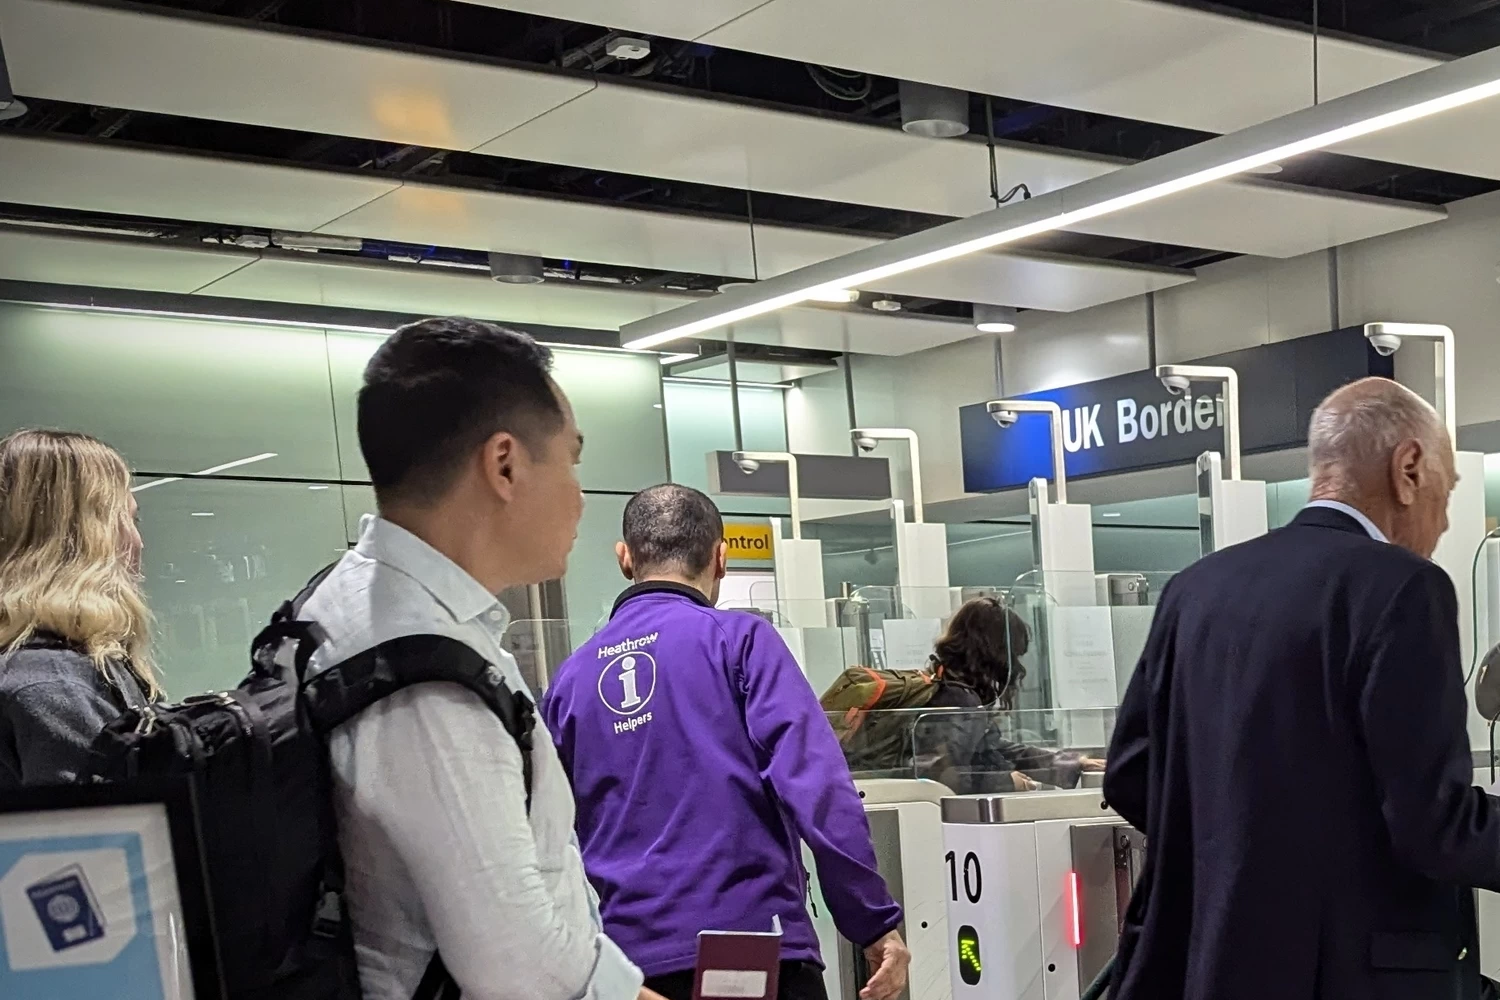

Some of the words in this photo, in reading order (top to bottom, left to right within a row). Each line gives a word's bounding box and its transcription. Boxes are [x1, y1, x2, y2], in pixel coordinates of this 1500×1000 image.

[1062, 404, 1105, 453] UK
[597, 632, 659, 660] Heathrow
[613, 711, 653, 734] Helpers
[945, 850, 983, 904] 10
